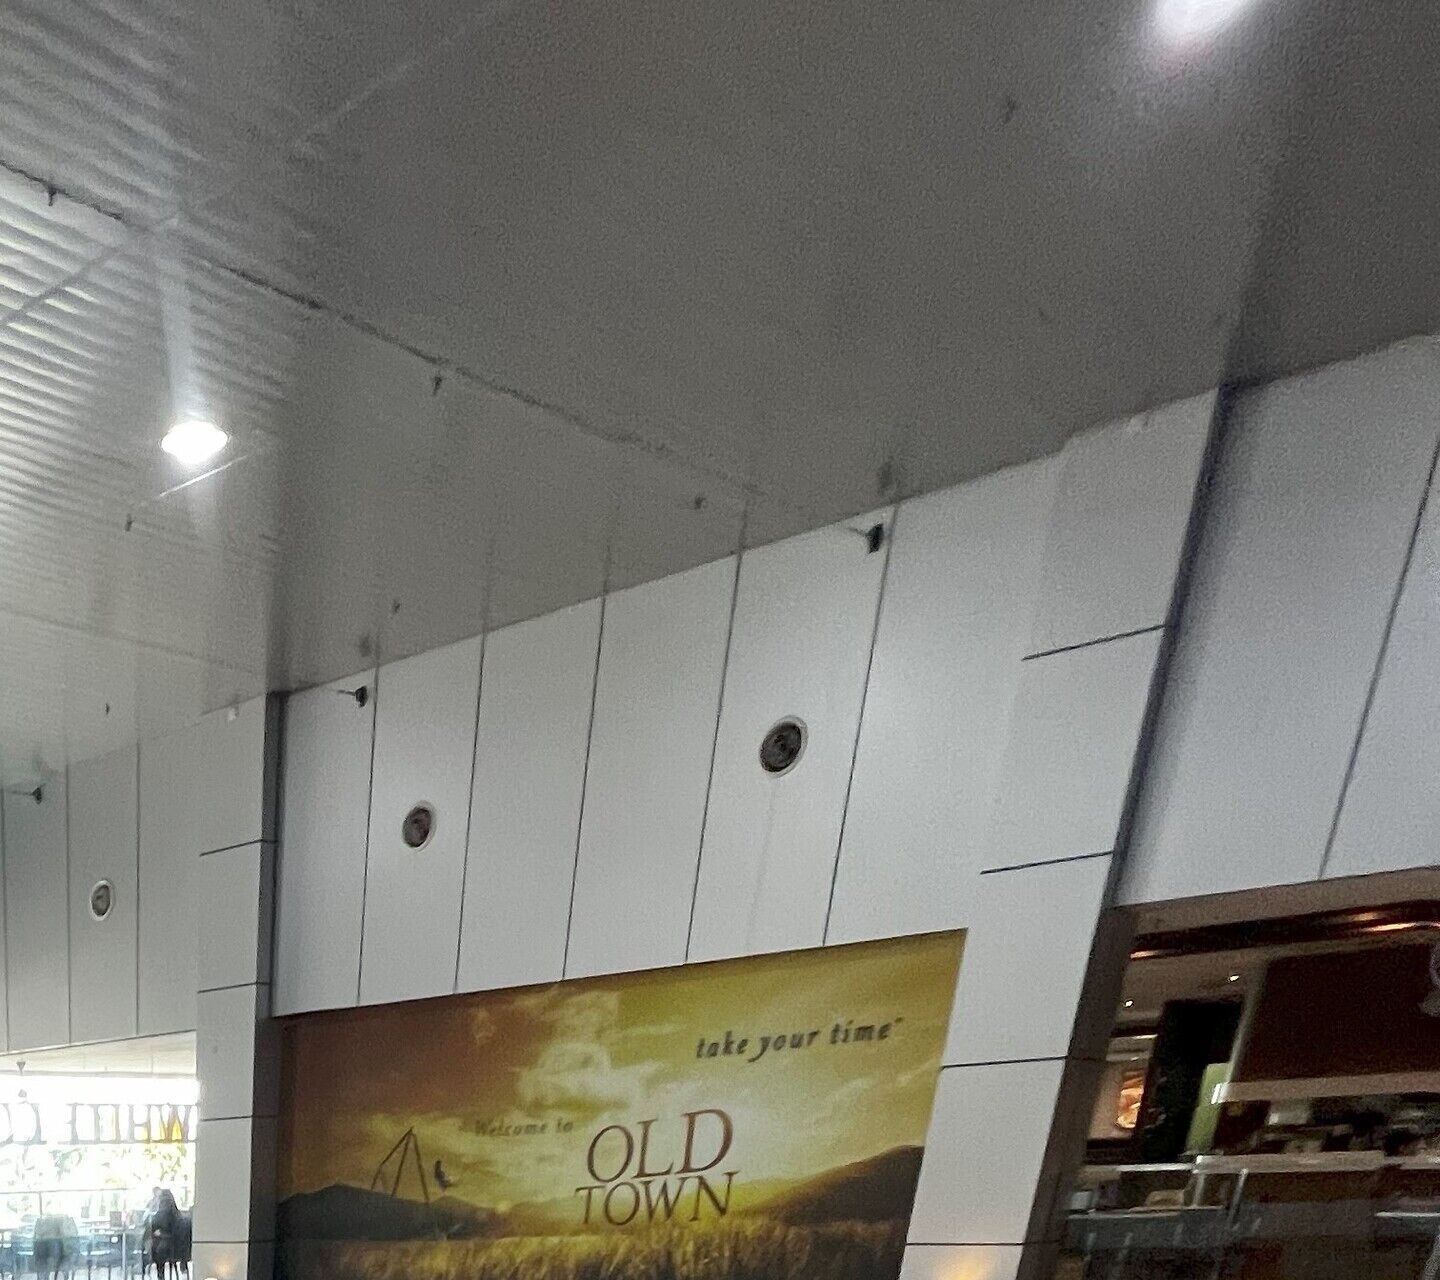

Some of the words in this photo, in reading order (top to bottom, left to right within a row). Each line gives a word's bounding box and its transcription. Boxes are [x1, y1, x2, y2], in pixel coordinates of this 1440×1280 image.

[696, 1030, 748, 1059] take
[747, 1029, 820, 1063] your
[474, 1117, 548, 1138] Welcome
[557, 1118, 574, 1134] to
[587, 1108, 734, 1183] OLD
[574, 1170, 741, 1226] TOWN
